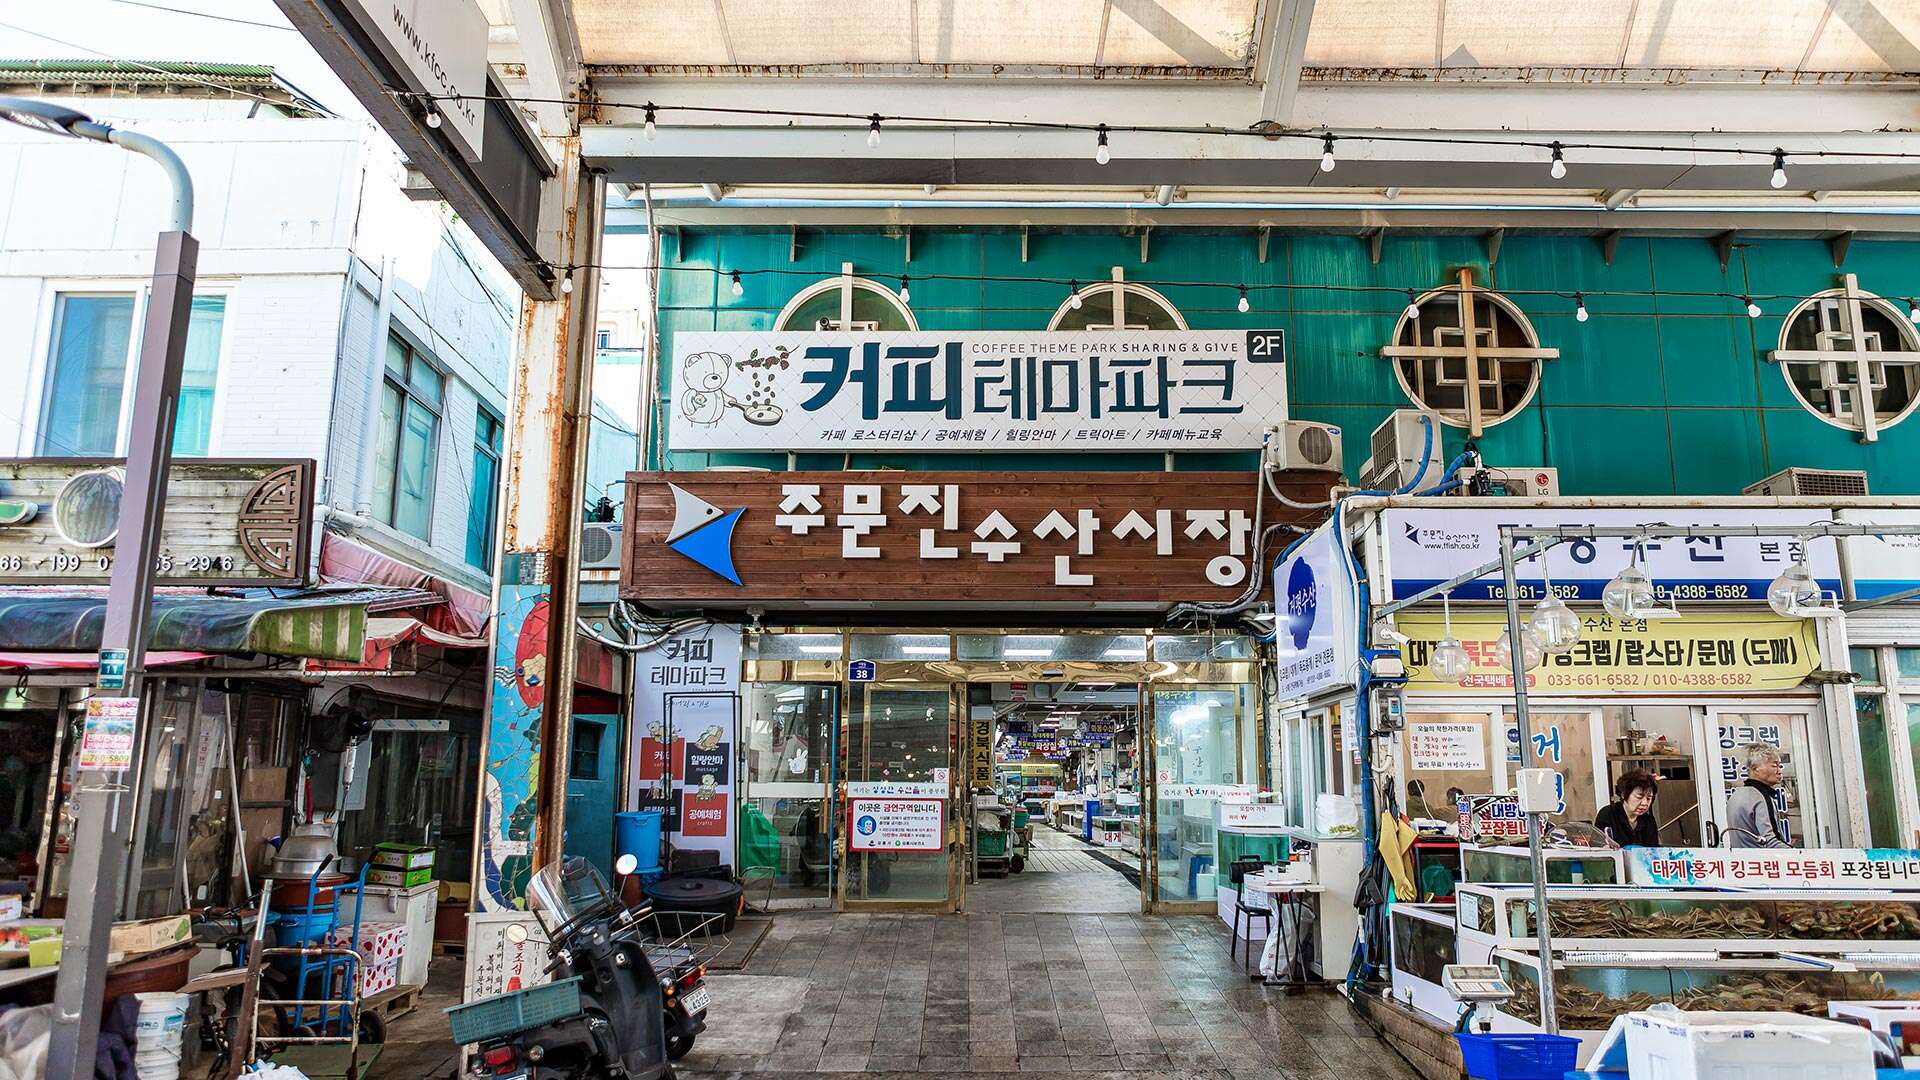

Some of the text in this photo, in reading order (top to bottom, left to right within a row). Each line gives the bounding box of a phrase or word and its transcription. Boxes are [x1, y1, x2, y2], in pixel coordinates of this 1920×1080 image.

[972, 335, 1281, 356] COFFEE THEME PARK SHARING & GIVE 2F
[800, 341, 1244, 421] 커피 테마파크
[820, 429, 846, 441] 카페
[851, 429, 918, 441] 로스터리샵
[935, 429, 987, 441] 공예체험
[1006, 428, 1057, 440] 힐링안마
[1075, 428, 1128, 440] 트릭아트
[1146, 428, 1223, 440] 카페메뉴교육
[775, 484, 1251, 587] 주문진수산시장
[667, 639, 713, 662] 커피
[651, 665, 727, 686] 테마파크
[856, 670, 868, 678] 38
[1547, 674, 1640, 686] 033-661-6582
[1653, 673, 1753, 686] 010-4388-6582
[689, 809, 722, 820] 공예체험
[858, 803, 881, 812] 이곳은
[1652, 860, 1686, 879] 대게
[1690, 860, 1725, 879] 홍게
[1730, 860, 1780, 879] 킹크랩
[1786, 860, 1835, 879] 모듬회
